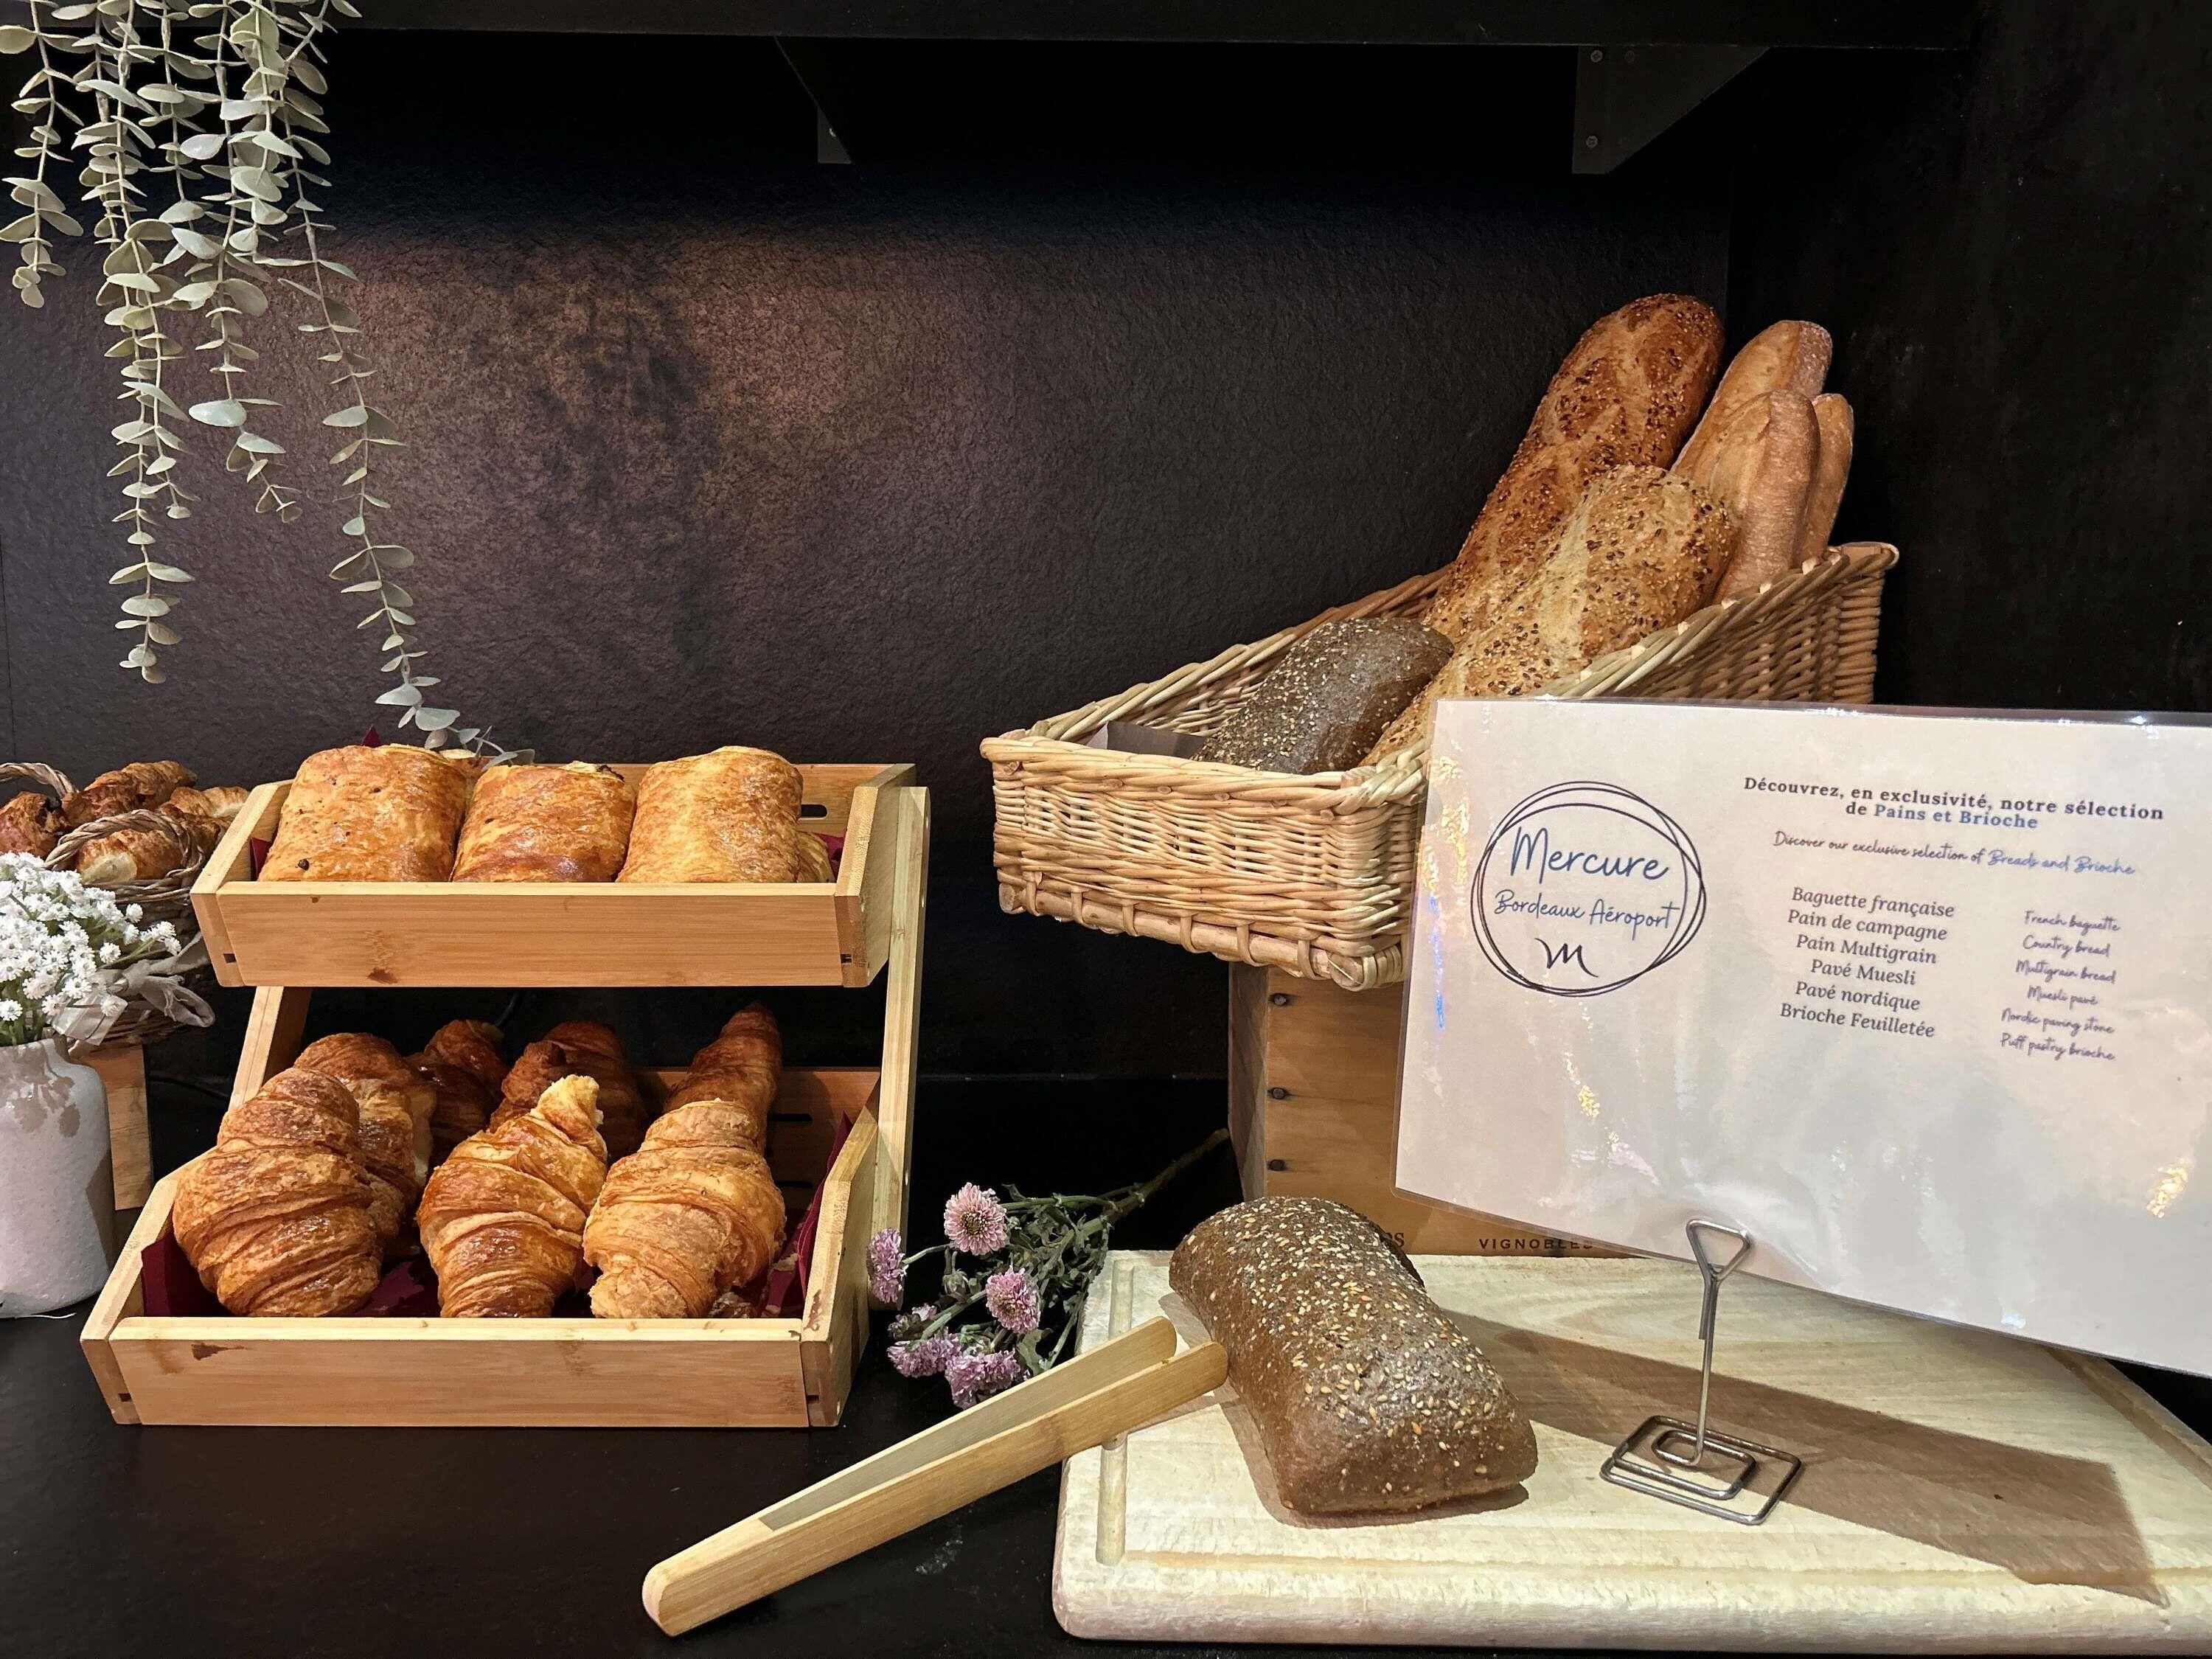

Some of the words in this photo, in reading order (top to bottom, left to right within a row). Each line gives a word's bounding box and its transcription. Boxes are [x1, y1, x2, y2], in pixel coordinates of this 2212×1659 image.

[1744, 777, 1845, 800] Découvrez,
[1851, 788, 1873, 800] en
[1880, 790, 1992, 810] exclusivité,
[2000, 799, 2056, 813] notre
[2065, 800, 2163, 820] sélection
[1845, 801, 1868, 815] de
[1874, 804, 1927, 821] Pains
[1933, 809, 1952, 823] et
[1958, 810, 2039, 830] Brioche
[1510, 826, 1669, 885] Mercure
[1773, 831, 1824, 846] Discover
[1829, 841, 1848, 851] our
[1851, 839, 1910, 858] exclusive
[1911, 842, 1968, 862] selection
[1971, 849, 1986, 865] of
[2041, 855, 2070, 872] and
[2073, 855, 2137, 875] Brioche
[1495, 888, 1586, 921] Bordeaux
[1589, 898, 1680, 941] Aéroport
[1791, 886, 1868, 908] Baguette
[1867, 894, 1955, 917] française
[1787, 909, 1827, 928] Pain
[1831, 915, 1852, 930] de
[1856, 920, 1948, 942] campagne
[2025, 910, 2068, 926] French
[2069, 914, 2121, 936] baguette
[1796, 934, 1835, 953] Pain
[1840, 940, 1937, 964] Multigrain
[2023, 934, 2073, 959] Country
[2075, 940, 2111, 957] bread
[1810, 959, 1852, 977] Pavé
[1856, 965, 1916, 985] Muesli
[2015, 960, 2078, 983] Multigrain
[2080, 966, 2117, 984] bread
[1795, 981, 1837, 999] Pavé
[1840, 990, 1921, 1012] nordique
[1780, 1003, 1846, 1025] Brioche
[1851, 1012, 1935, 1038] Feuilletée
[2000, 1032, 2028, 1050] Puff
[2028, 1037, 2066, 1061] pastry
[2069, 1043, 2115, 1060] brioche
